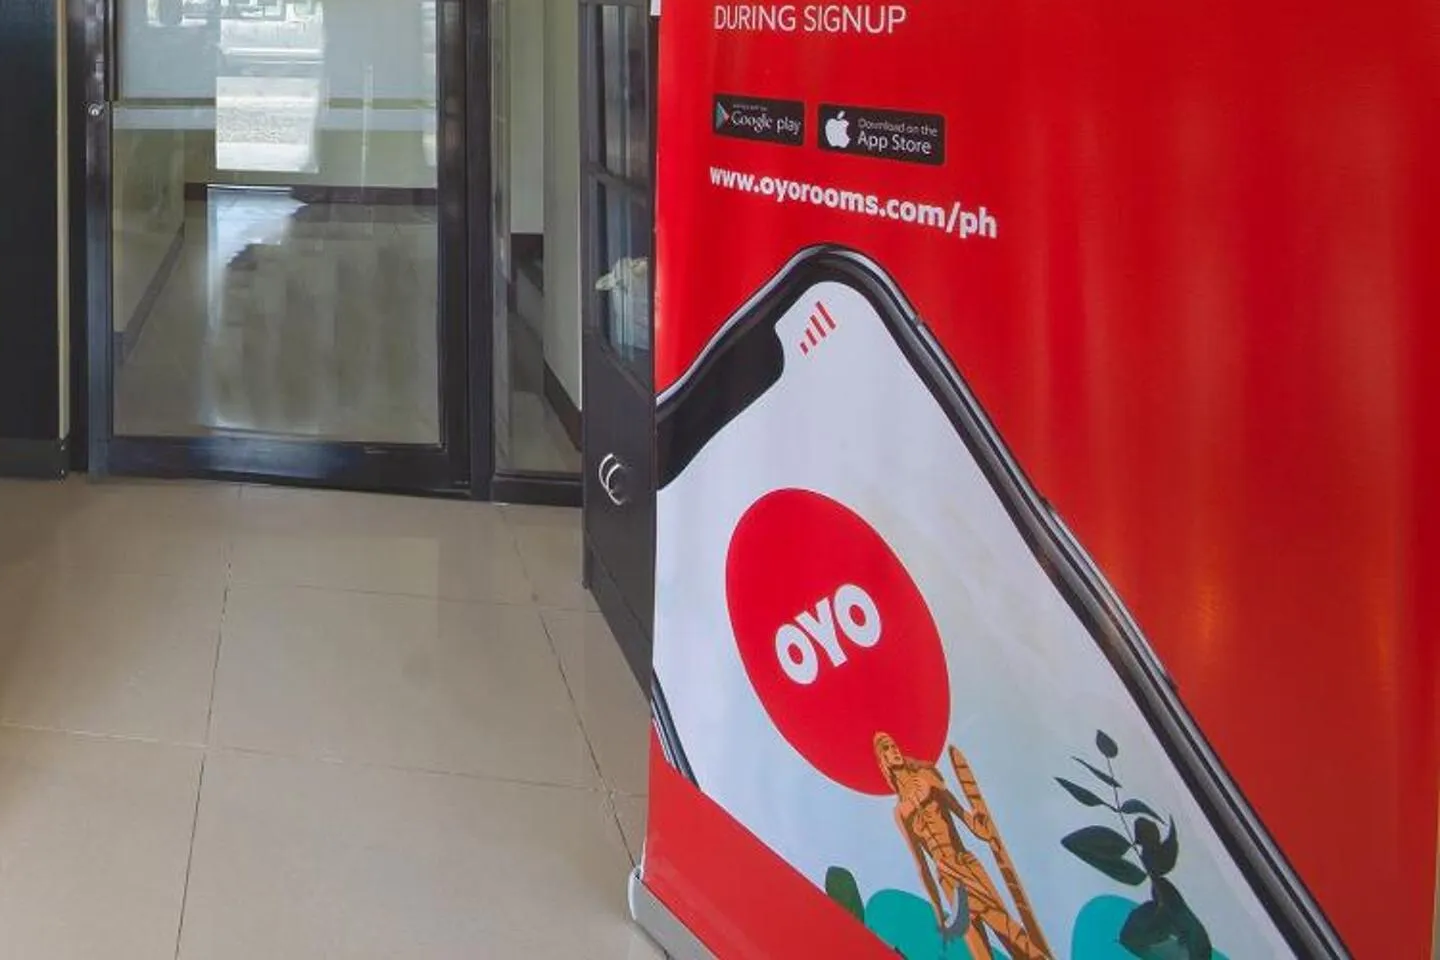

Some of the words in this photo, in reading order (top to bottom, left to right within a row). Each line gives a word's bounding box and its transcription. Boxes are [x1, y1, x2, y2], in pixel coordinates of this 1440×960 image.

[714, 5, 796, 31] DURING
[804, 5, 907, 33] SIGNUP
[731, 110, 772, 133] Google
[777, 116, 802, 136] play
[858, 117, 906, 133] Download
[921, 123, 938, 137] the
[857, 131, 888, 153] App
[892, 134, 932, 155] Store
[710, 166, 997, 239] www.oyorooms.com/ph
[775, 583, 882, 685] OYO
